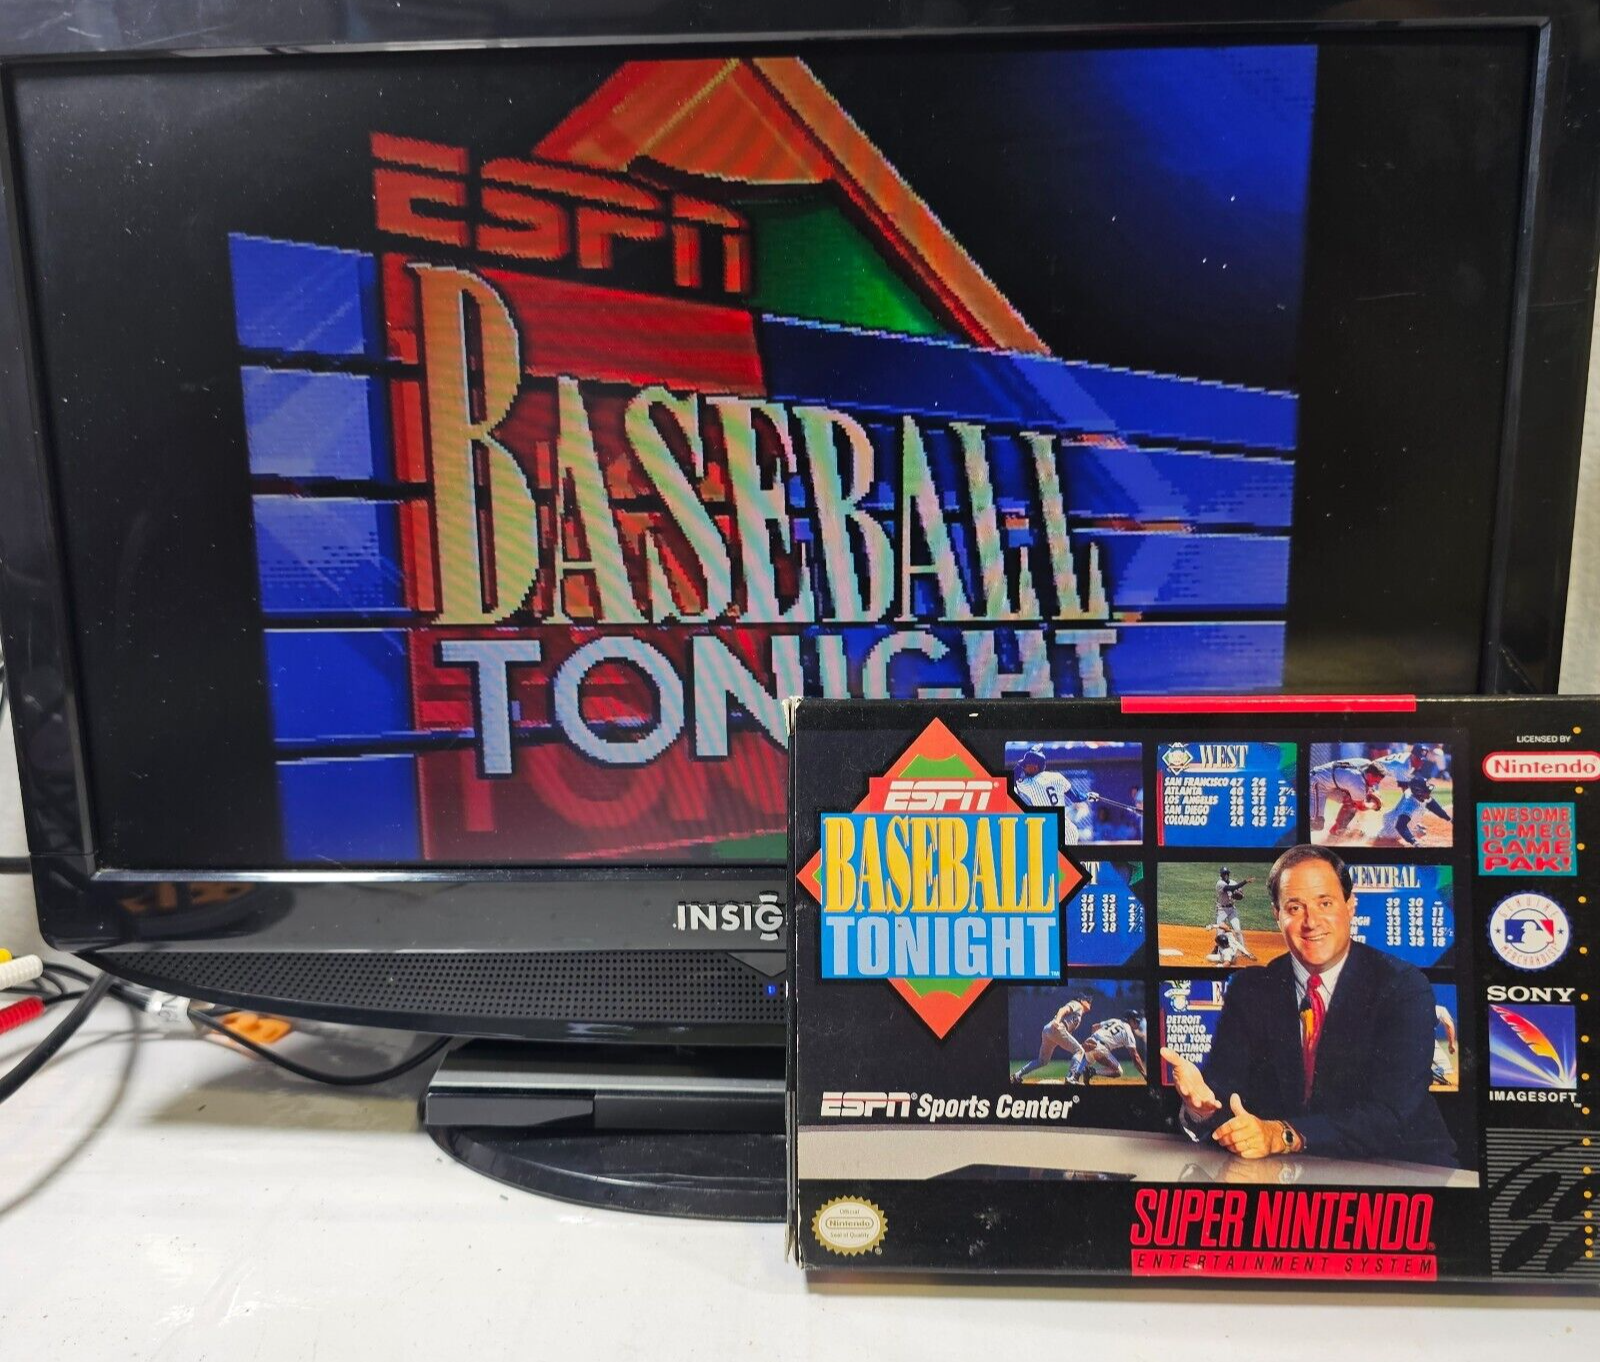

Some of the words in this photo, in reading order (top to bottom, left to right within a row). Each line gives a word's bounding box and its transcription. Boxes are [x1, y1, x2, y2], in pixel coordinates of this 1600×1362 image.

[371, 133, 748, 294] ESPN
[407, 261, 1110, 625] BASEBALL
[440, 627, 1117, 776] TONIGHT
[1516, 735, 1558, 743] LICENSED
[1559, 735, 1571, 743] BY
[1199, 745, 1248, 769] WEST
[1494, 758, 1596, 774] Nintendo
[1164, 777, 1181, 786] SAN
[1183, 777, 1229, 786] FRANCISCO
[1230, 777, 1244, 787] 47
[1251, 777, 1267, 787] 24
[884, 780, 993, 811] ESPN
[1046, 786, 1059, 806] 6
[1164, 787, 1202, 795] ATLANTA
[1230, 787, 1244, 796] 40
[1251, 787, 1267, 796] 32
[1164, 796, 1180, 804] LOS
[1182, 796, 1219, 804] ANGELES
[1230, 796, 1244, 805] 36
[1251, 796, 1267, 805] 31
[1278, 796, 1287, 805] 9
[1164, 805, 1181, 815] SAN
[1184, 805, 1209, 815] DIEGO
[1230, 805, 1244, 816] 28
[1251, 805, 1267, 816] 42
[1481, 807, 1571, 822] AWESOME
[1164, 816, 1208, 826] COLORADO
[1230, 816, 1244, 827] 24
[1251, 816, 1267, 827] 45
[1272, 816, 1287, 827] 22
[1482, 823, 1571, 838] 16-MEG
[1482, 839, 1573, 855] GAME
[823, 815, 1055, 914] BASEBALL
[1484, 856, 1571, 872] PAK!
[1349, 866, 1420, 888] CENTRAL
[1081, 894, 1094, 903] 35
[1102, 894, 1116, 903] 33
[1386, 897, 1400, 907] 39
[1408, 897, 1424, 907] 30
[1081, 903, 1094, 912] 34
[1102, 903, 1116, 912] 35
[1386, 907, 1400, 916] 34
[1408, 907, 1424, 916] 33
[1432, 907, 1444, 917] 11
[1081, 912, 1094, 922] 31
[1102, 912, 1116, 922] 38
[1386, 916, 1400, 926] 33
[1408, 916, 1424, 926] 34
[1432, 917, 1444, 926] 15
[1081, 922, 1095, 933] 27
[1102, 922, 1116, 933] 38
[1386, 926, 1400, 936] 33
[1408, 926, 1424, 936] 36
[826, 916, 1056, 976] TONIGHT
[1387, 936, 1401, 946] 33
[1409, 936, 1425, 947] 38
[1432, 937, 1446, 947] 18
[1487, 985, 1575, 1002] SONY
[1166, 1015, 1201, 1024] DETROIT
[1167, 1024, 1206, 1033] TORONTO
[1167, 1034, 1186, 1043] NEW
[1190, 1034, 1212, 1043] YORK
[1489, 1091, 1577, 1102] IMAGESOFT
[821, 1091, 911, 1117] ESPN
[917, 1093, 990, 1122] Sports
[996, 1094, 1073, 1119] Center
[1130, 1189, 1247, 1247] SUPER
[1253, 1191, 1433, 1250] NINTENDO
[1137, 1253, 1328, 1272] ENTERTAINMENT
[1345, 1257, 1432, 1273] SYSTEM
